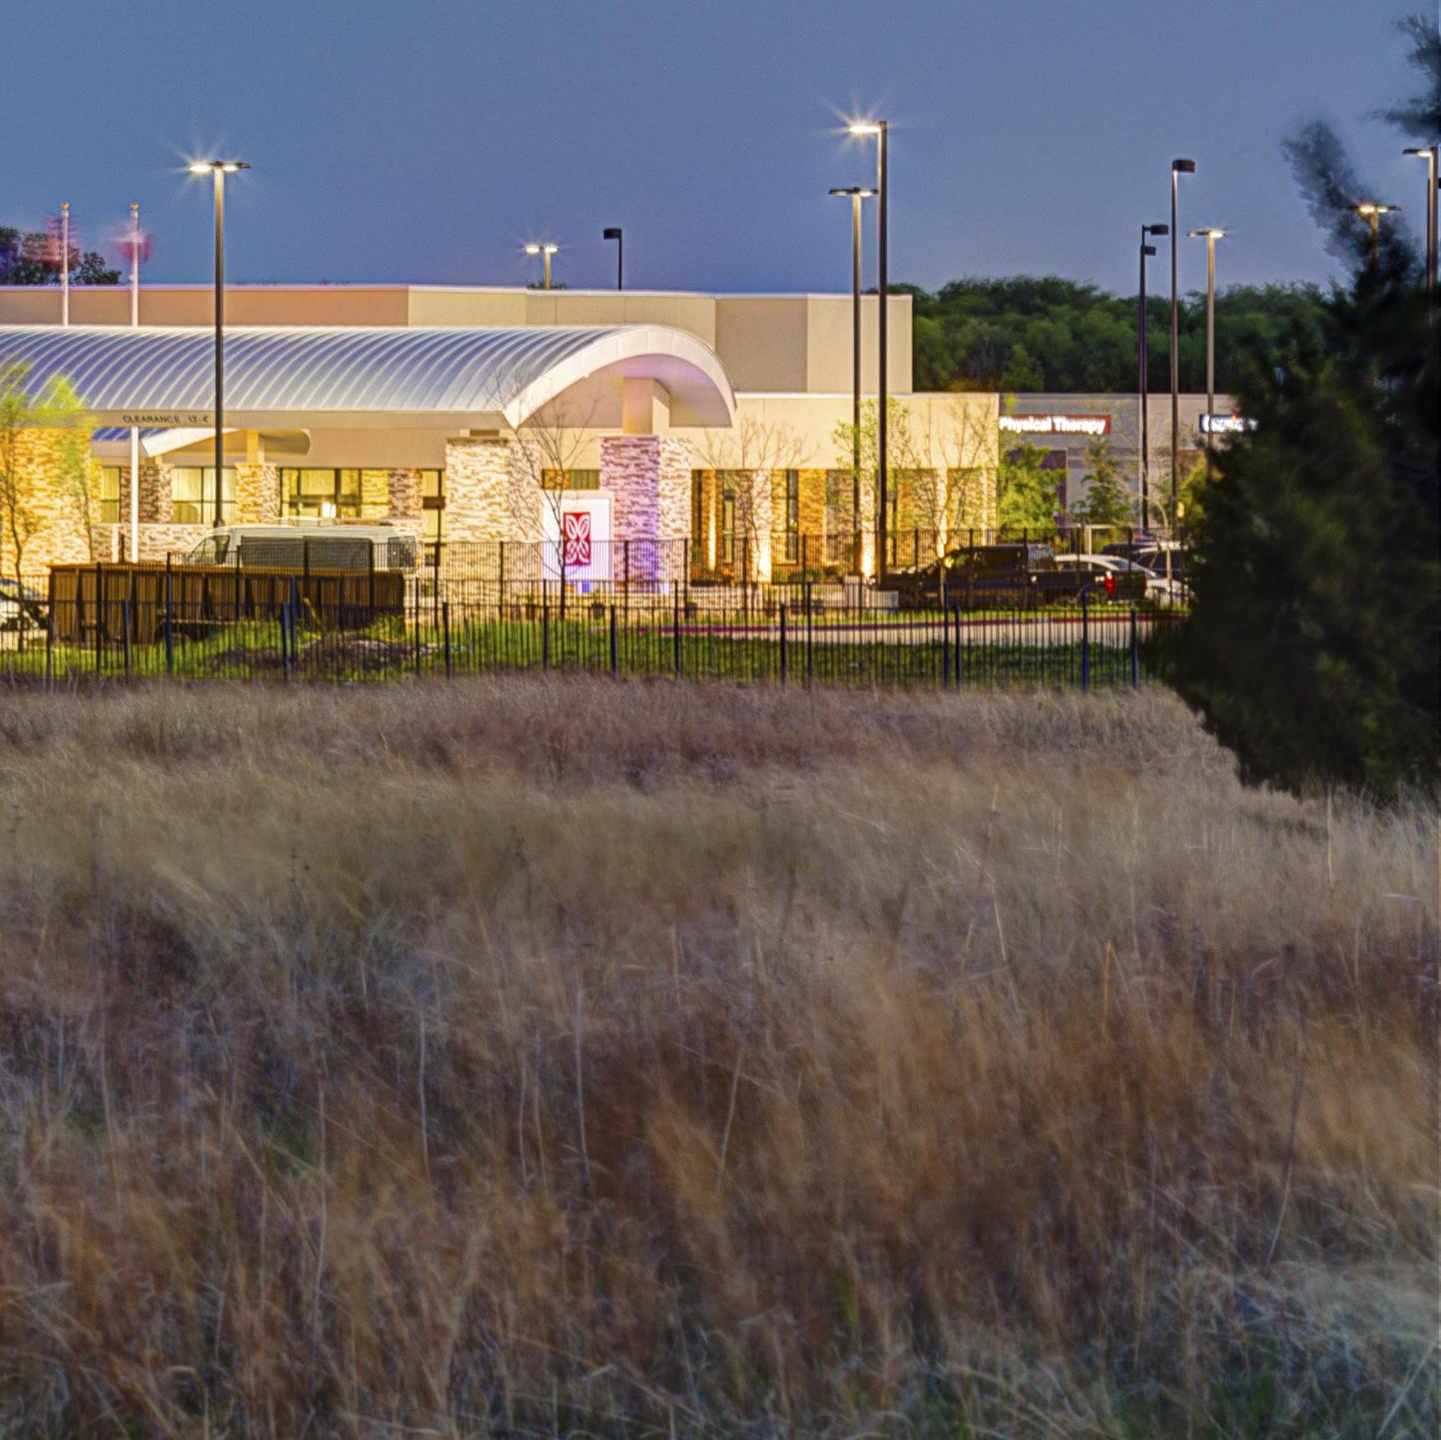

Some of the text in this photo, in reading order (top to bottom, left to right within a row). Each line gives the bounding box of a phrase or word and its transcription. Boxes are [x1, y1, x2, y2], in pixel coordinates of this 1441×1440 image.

[122, 414, 181, 424] CLEARANCE
[999, 415, 1106, 435] Physical Therapy
